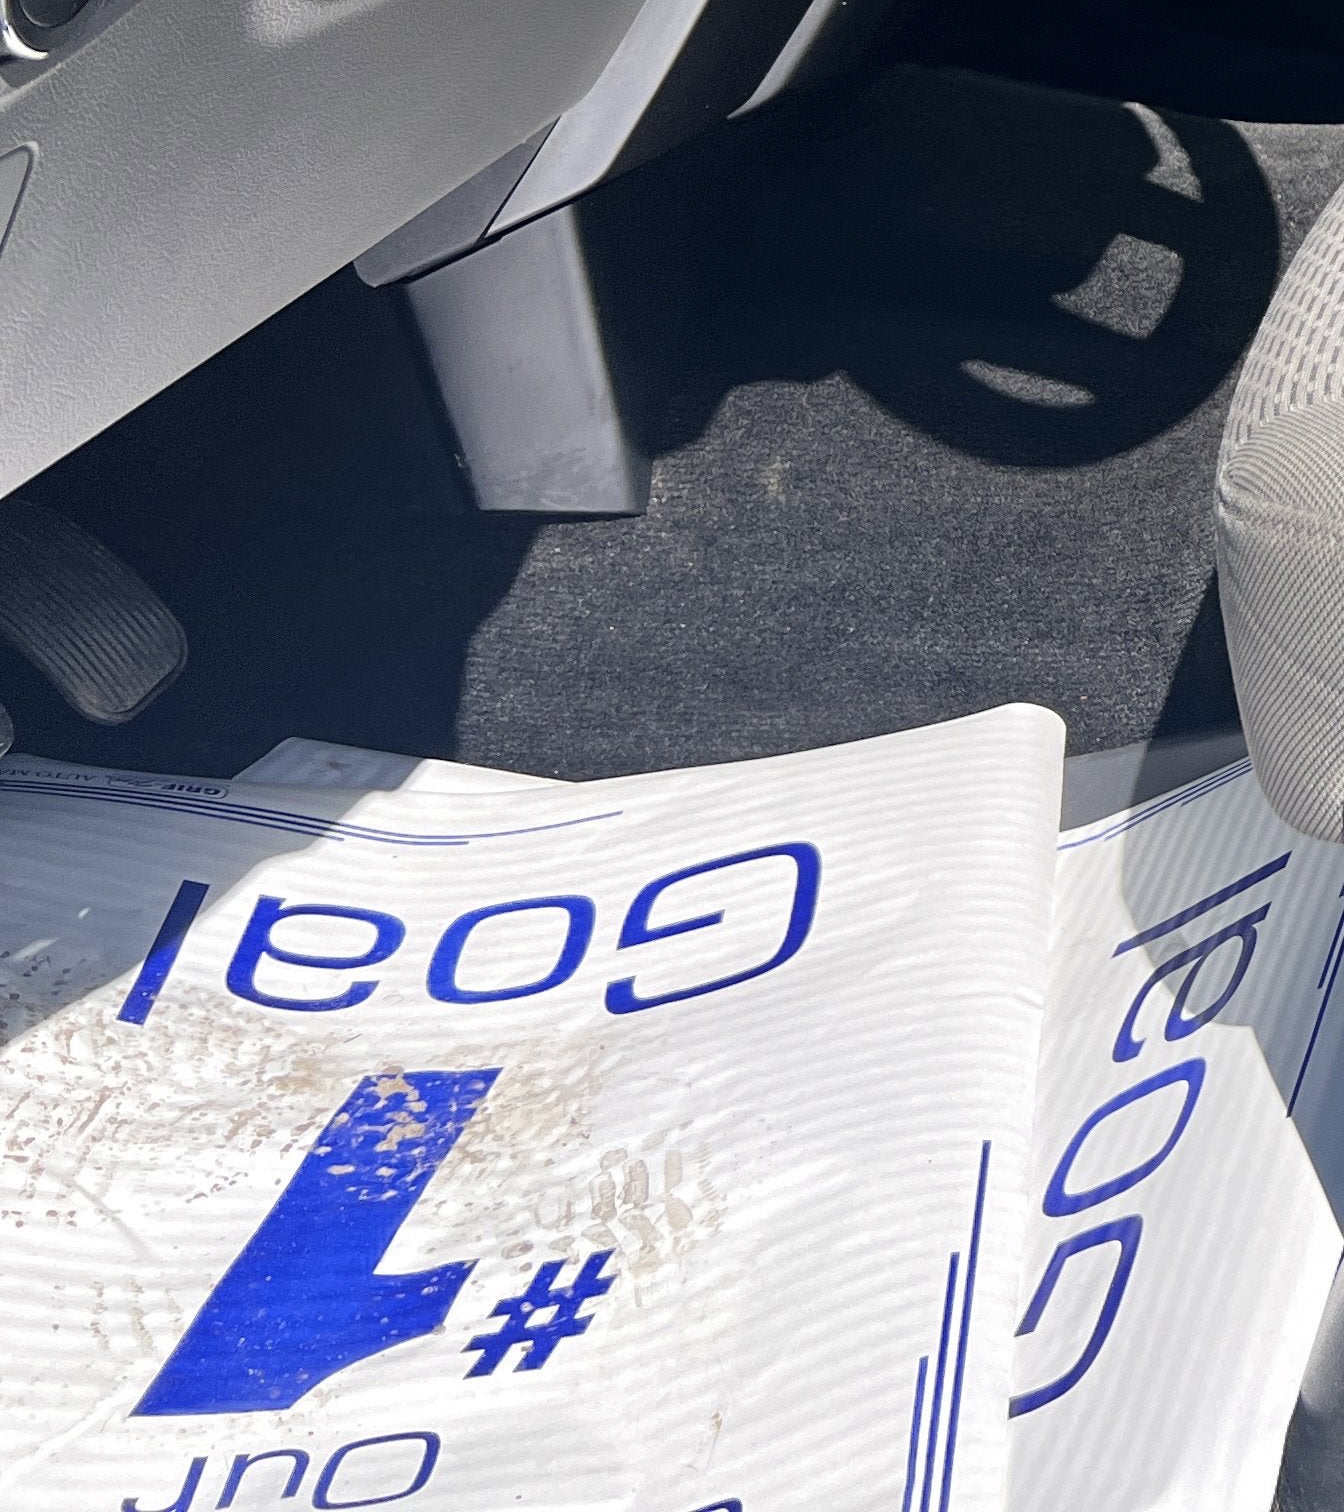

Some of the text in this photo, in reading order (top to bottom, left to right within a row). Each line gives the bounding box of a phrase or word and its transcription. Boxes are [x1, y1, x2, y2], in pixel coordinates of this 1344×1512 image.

[116, 840, 822, 1026] Goal
[1007, 849, 1293, 1420] Goal
[121, 1430, 442, 1512] Our
